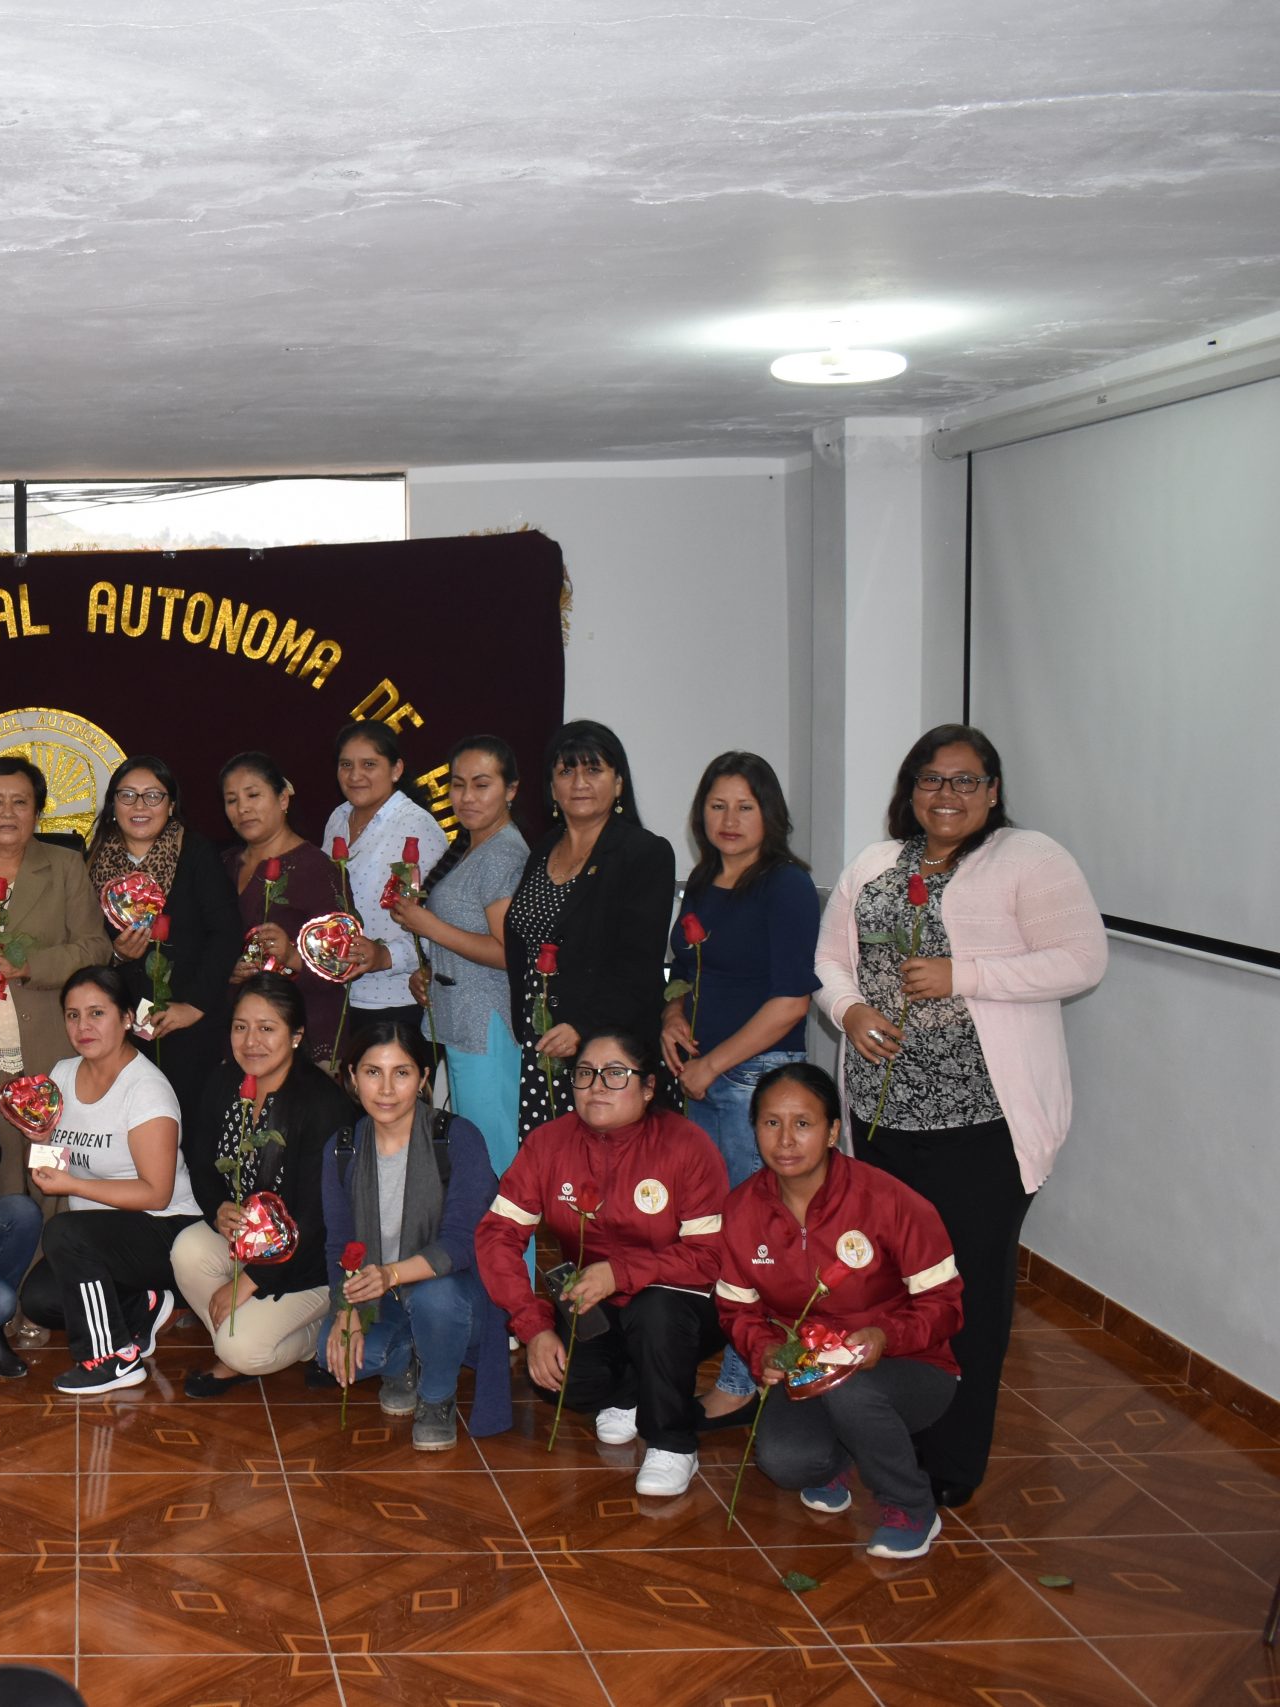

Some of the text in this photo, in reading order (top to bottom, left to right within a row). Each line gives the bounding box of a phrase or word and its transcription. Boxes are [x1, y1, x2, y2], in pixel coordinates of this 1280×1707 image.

[86, 581, 342, 689] AUTONOMA
[36, 713, 109, 753] AUTONOMA
[51, 1129, 113, 1148] DEPENDENT
